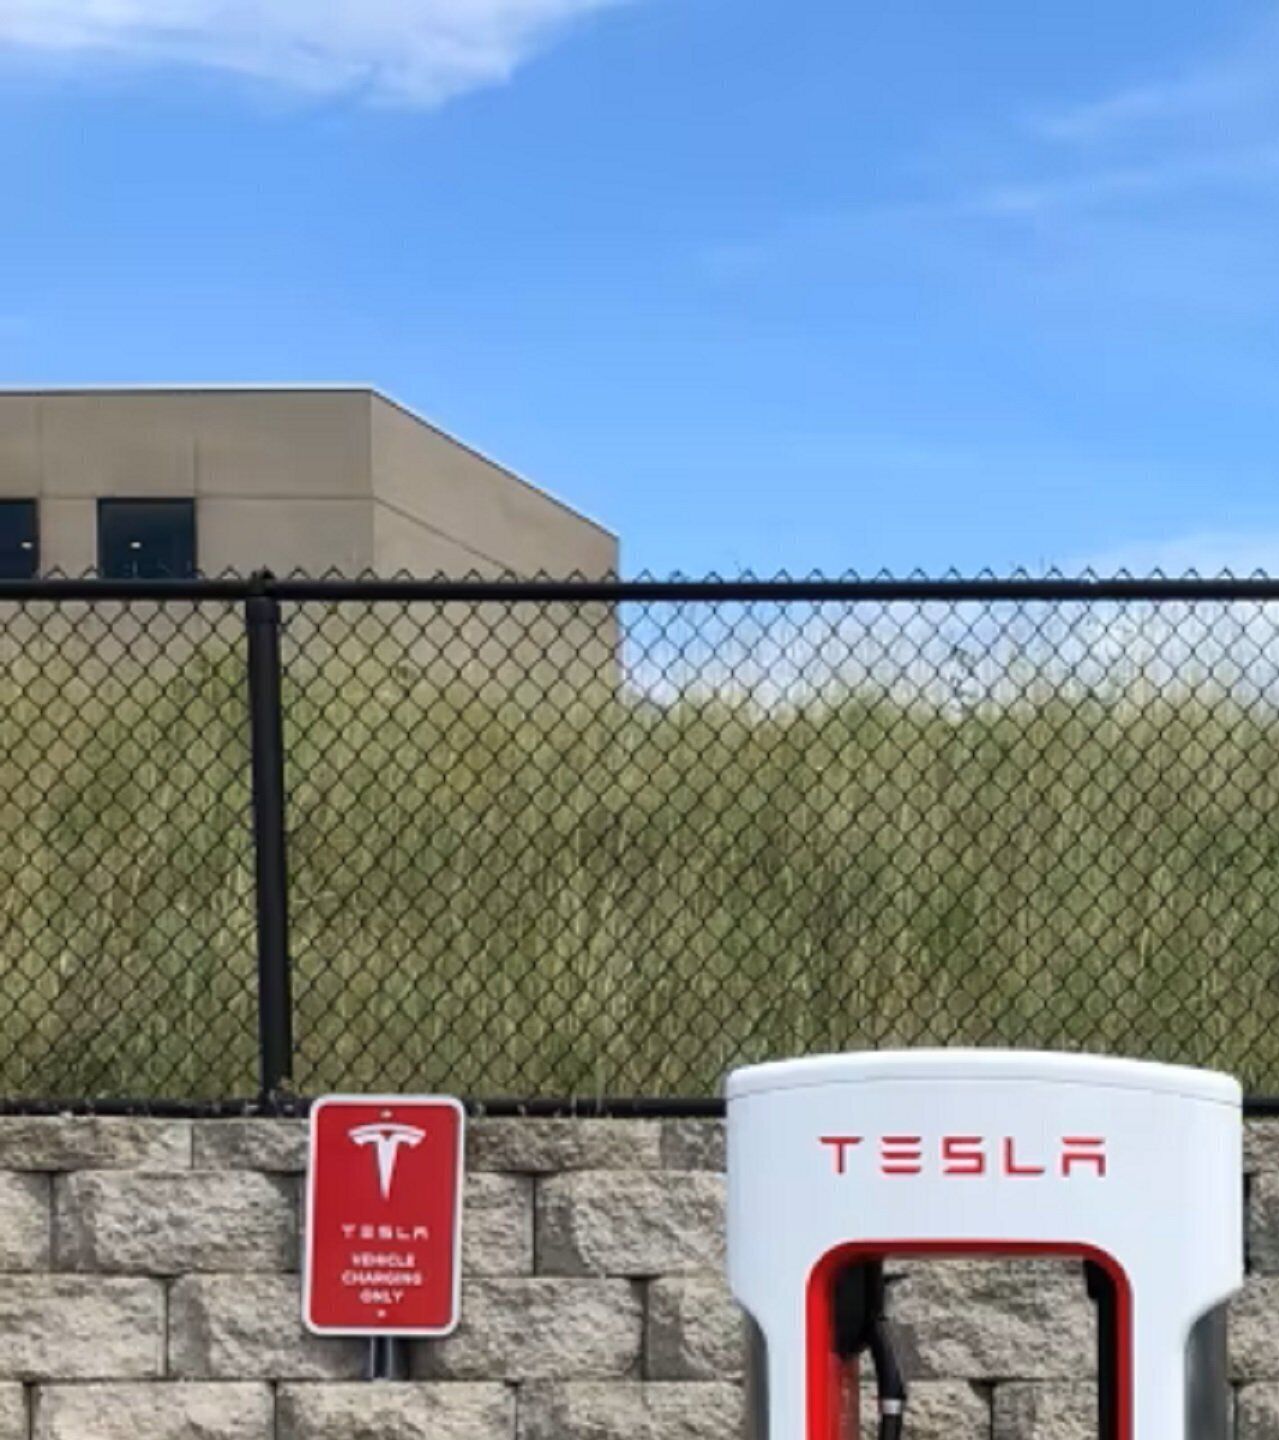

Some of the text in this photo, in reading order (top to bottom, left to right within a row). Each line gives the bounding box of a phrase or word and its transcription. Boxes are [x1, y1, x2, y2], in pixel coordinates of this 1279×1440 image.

[816, 1136, 1107, 1177] TESLA
[341, 1223, 429, 1240] TESLA
[352, 1251, 416, 1268] VEHICLE
[341, 1270, 423, 1286] CHARGING
[359, 1289, 404, 1304] ONLY
